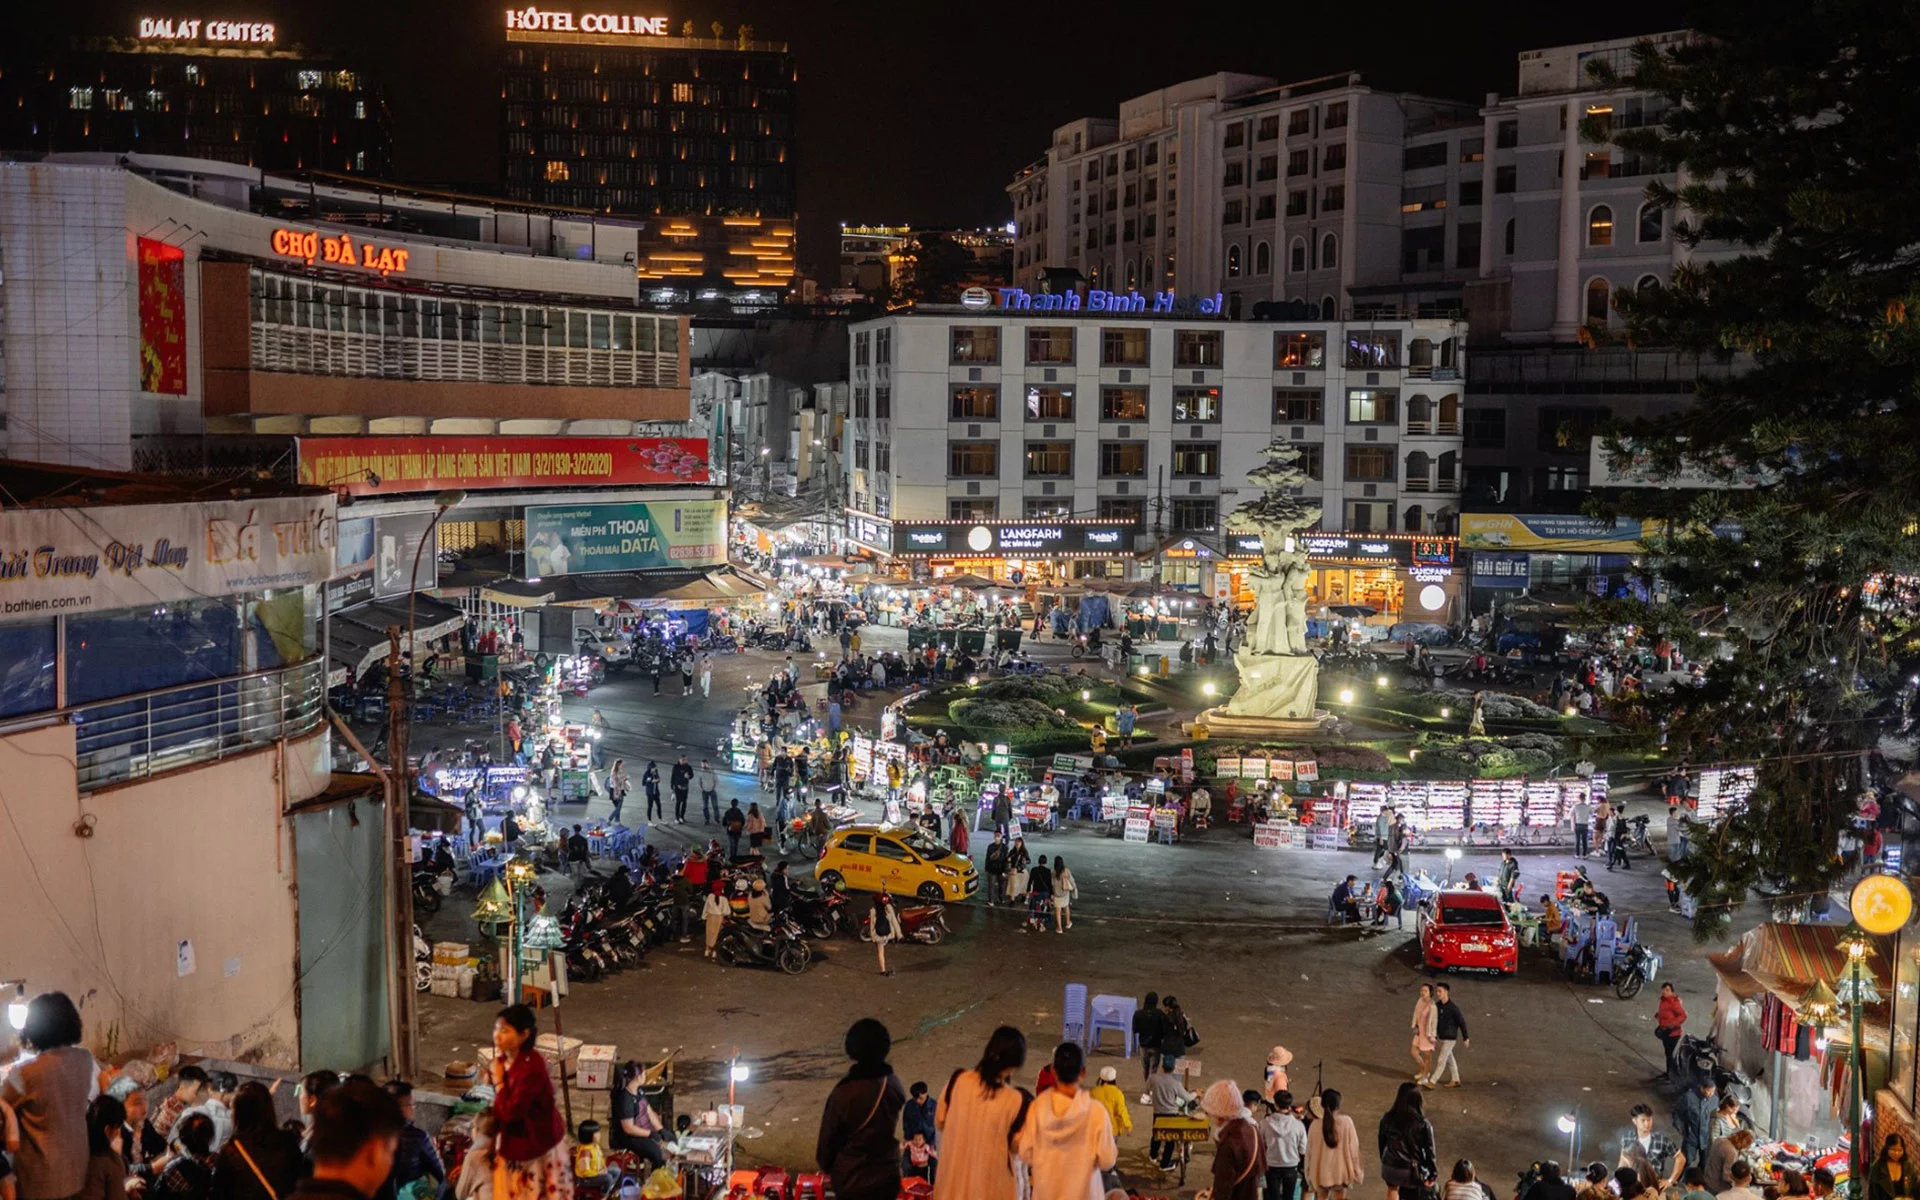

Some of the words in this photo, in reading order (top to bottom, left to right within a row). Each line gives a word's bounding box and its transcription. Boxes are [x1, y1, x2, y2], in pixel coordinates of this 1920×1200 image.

[139, 17, 201, 39] DALAT
[205, 20, 275, 42] CENTER
[506, 7, 578, 31] HÔTEL
[580, 14, 668, 35] COLLINE
[271, 228, 318, 266] CHỢ
[321, 233, 357, 266] ĐÀ
[361, 244, 409, 276] LẠT
[998, 289, 1081, 311] Thanh
[457, 448, 478, 483] CỘNG
[479, 445, 495, 478] SẢN
[495, 448, 512, 482] VIỆT
[512, 452, 531, 477] NAM
[533, 452, 613, 478] (3/2/1930-3/2/2020)
[608, 519, 649, 537] THOẠI
[1487, 519, 1514, 529] GHN
[1000, 529, 1062, 540] L'ANGFARM
[621, 538, 660, 554] DATA
[33, 545, 99, 581] Trang
[104, 540, 144, 577] Dệt
[1513, 562, 1527, 576] XE
[1409, 567, 1451, 576] L'ANGFARM
[0, 594, 92, 614] .bathien.com.vn
